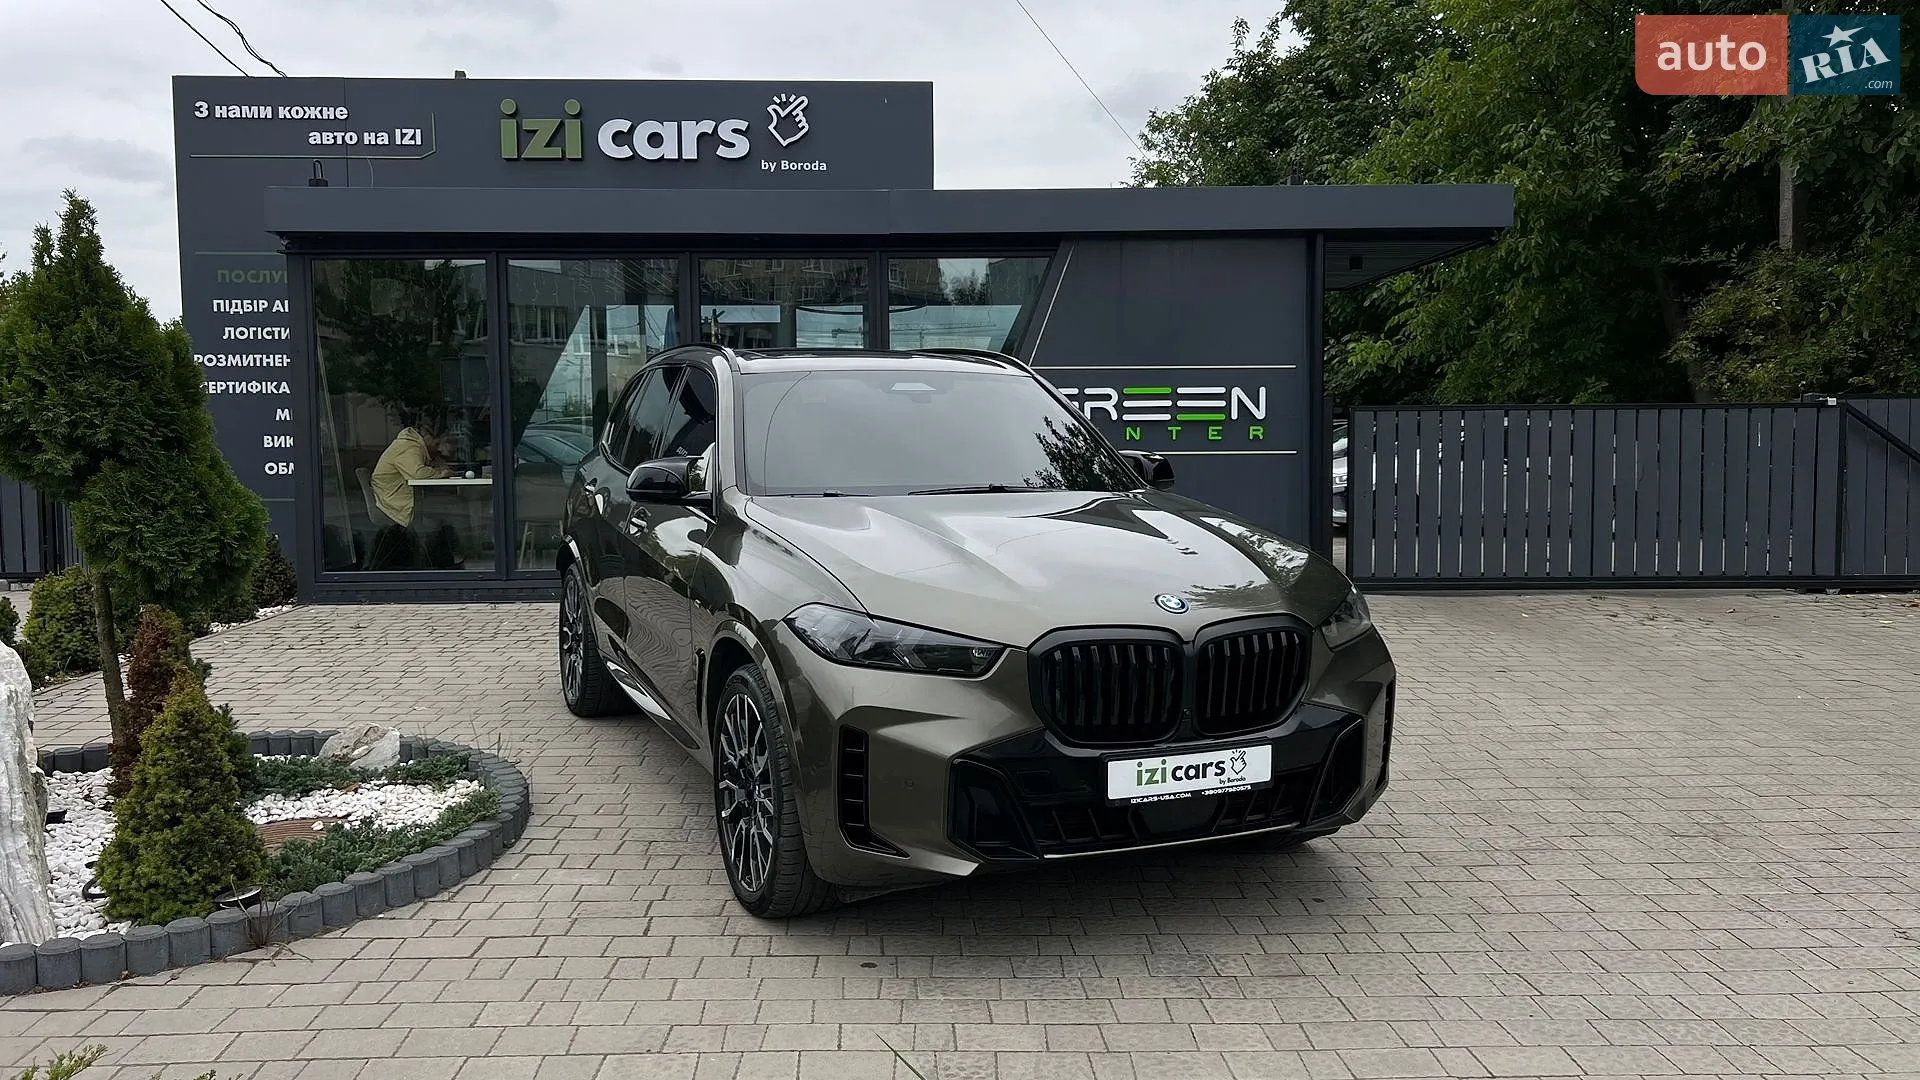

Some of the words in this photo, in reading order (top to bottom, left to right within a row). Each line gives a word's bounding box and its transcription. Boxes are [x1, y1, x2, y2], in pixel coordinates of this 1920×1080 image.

[194, 101, 209, 119] З
[215, 105, 272, 119] нами
[278, 105, 349, 120] кожне
[308, 129, 358, 145] авто
[363, 131, 390, 145] на
[394, 128, 422, 145] IZI
[500, 98, 583, 159] izi
[597, 117, 751, 160] cars
[761, 159, 777, 173] by
[780, 159, 828, 172] Boroda
[212, 299, 269, 315] ПІДБІР
[1125, 425, 1264, 441] NTER
[1136, 758, 1167, 787] izi
[1171, 760, 1226, 782] cars
